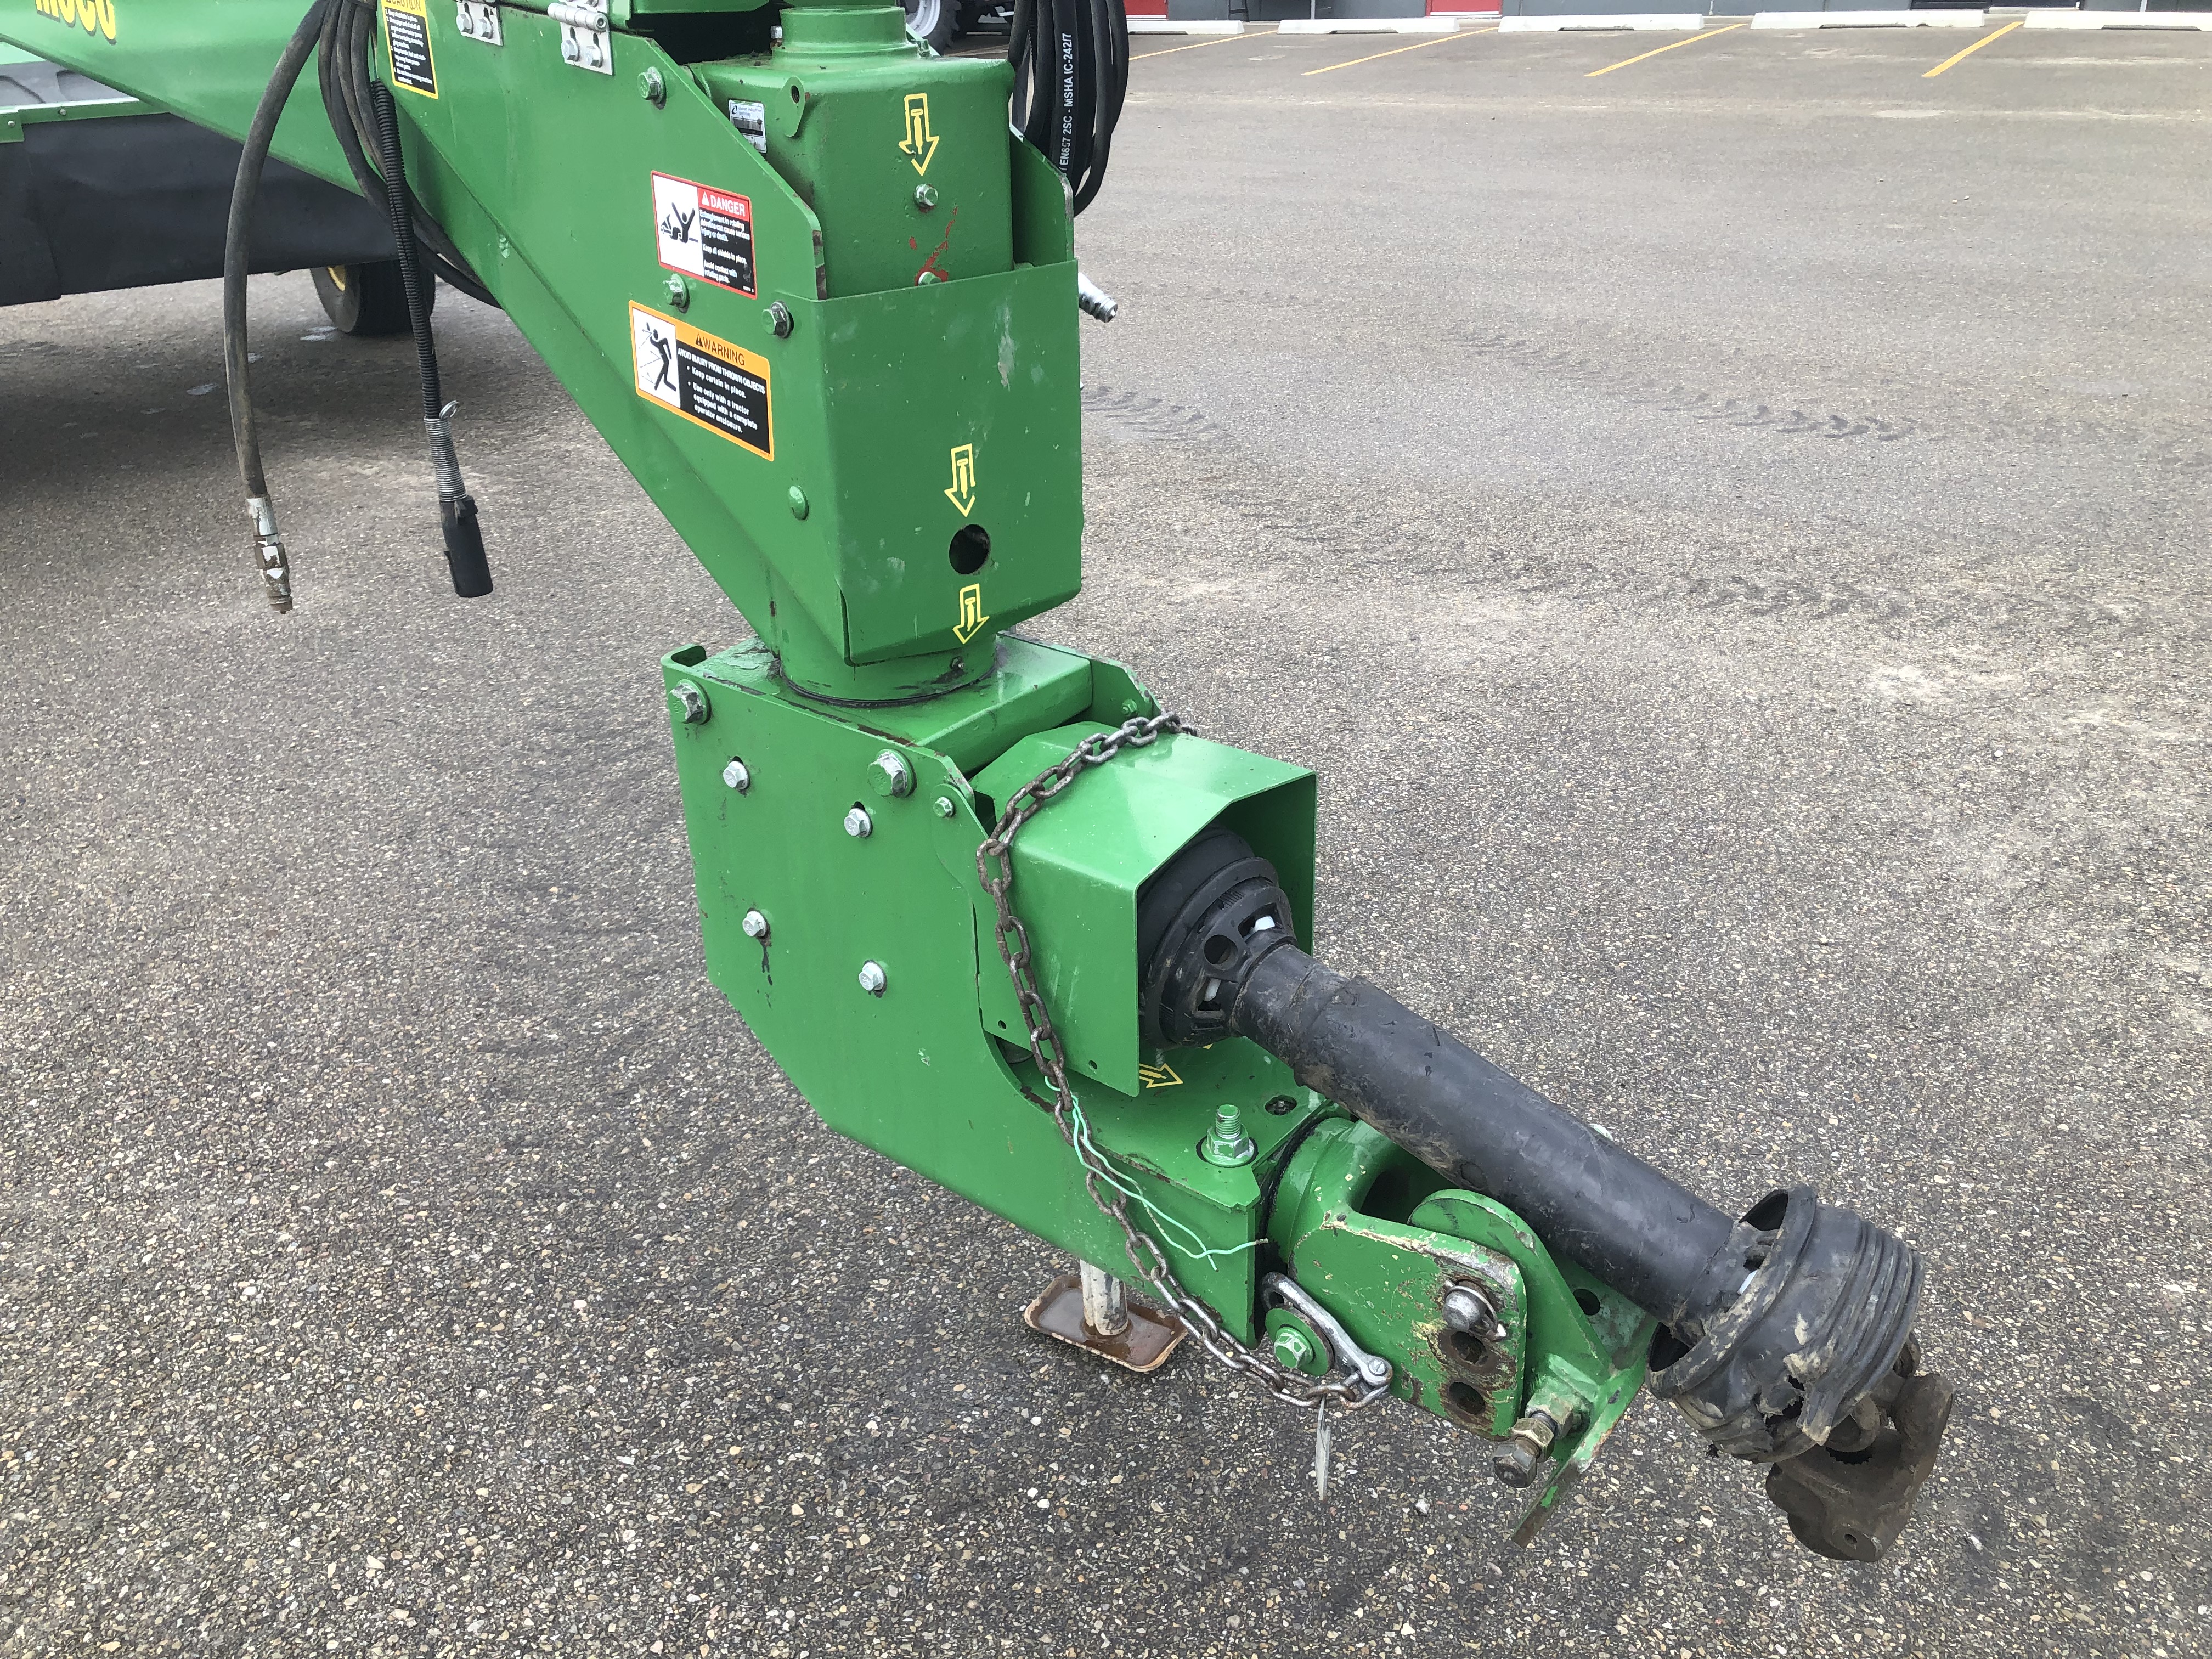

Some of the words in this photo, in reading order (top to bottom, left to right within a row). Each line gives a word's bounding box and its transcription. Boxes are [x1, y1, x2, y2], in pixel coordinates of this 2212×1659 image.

[1063, 76, 1073, 107] MSHA
[1063, 113, 1073, 135] 2SC
[1059, 137, 1070, 165] EN857
[710, 194, 746, 217] DANGER
[716, 224, 724, 232] can
[724, 226, 736, 236] cause
[736, 230, 751, 241] serious
[729, 219, 745, 232] rotating
[702, 242, 712, 255] Keep
[717, 249, 731, 260] shields
[704, 259, 715, 270] Avoid
[714, 264, 729, 275] contact
[729, 268, 737, 278] with
[704, 269, 719, 281] rotating
[703, 336, 745, 366] WARNING
[678, 347, 692, 360] AVOID
[691, 353, 708, 368] INJURY
[708, 360, 722, 375] FROM
[721, 367, 743, 385] THROWN
[743, 376, 765, 394] OBJECTS
[692, 366, 705, 380] Keep
[706, 374, 724, 388] curtain
[724, 381, 730, 391] in
[730, 385, 747, 399] place.
[693, 381, 703, 393] Use
[703, 388, 715, 400] only
[715, 393, 726, 405] with
[731, 400, 749, 415] tractor
[693, 394, 716, 410] equipped
[717, 405, 729, 416] with
[733, 413, 758, 430] complete
[694, 404, 715, 419] operator
[716, 415, 743, 433] enclosure.
